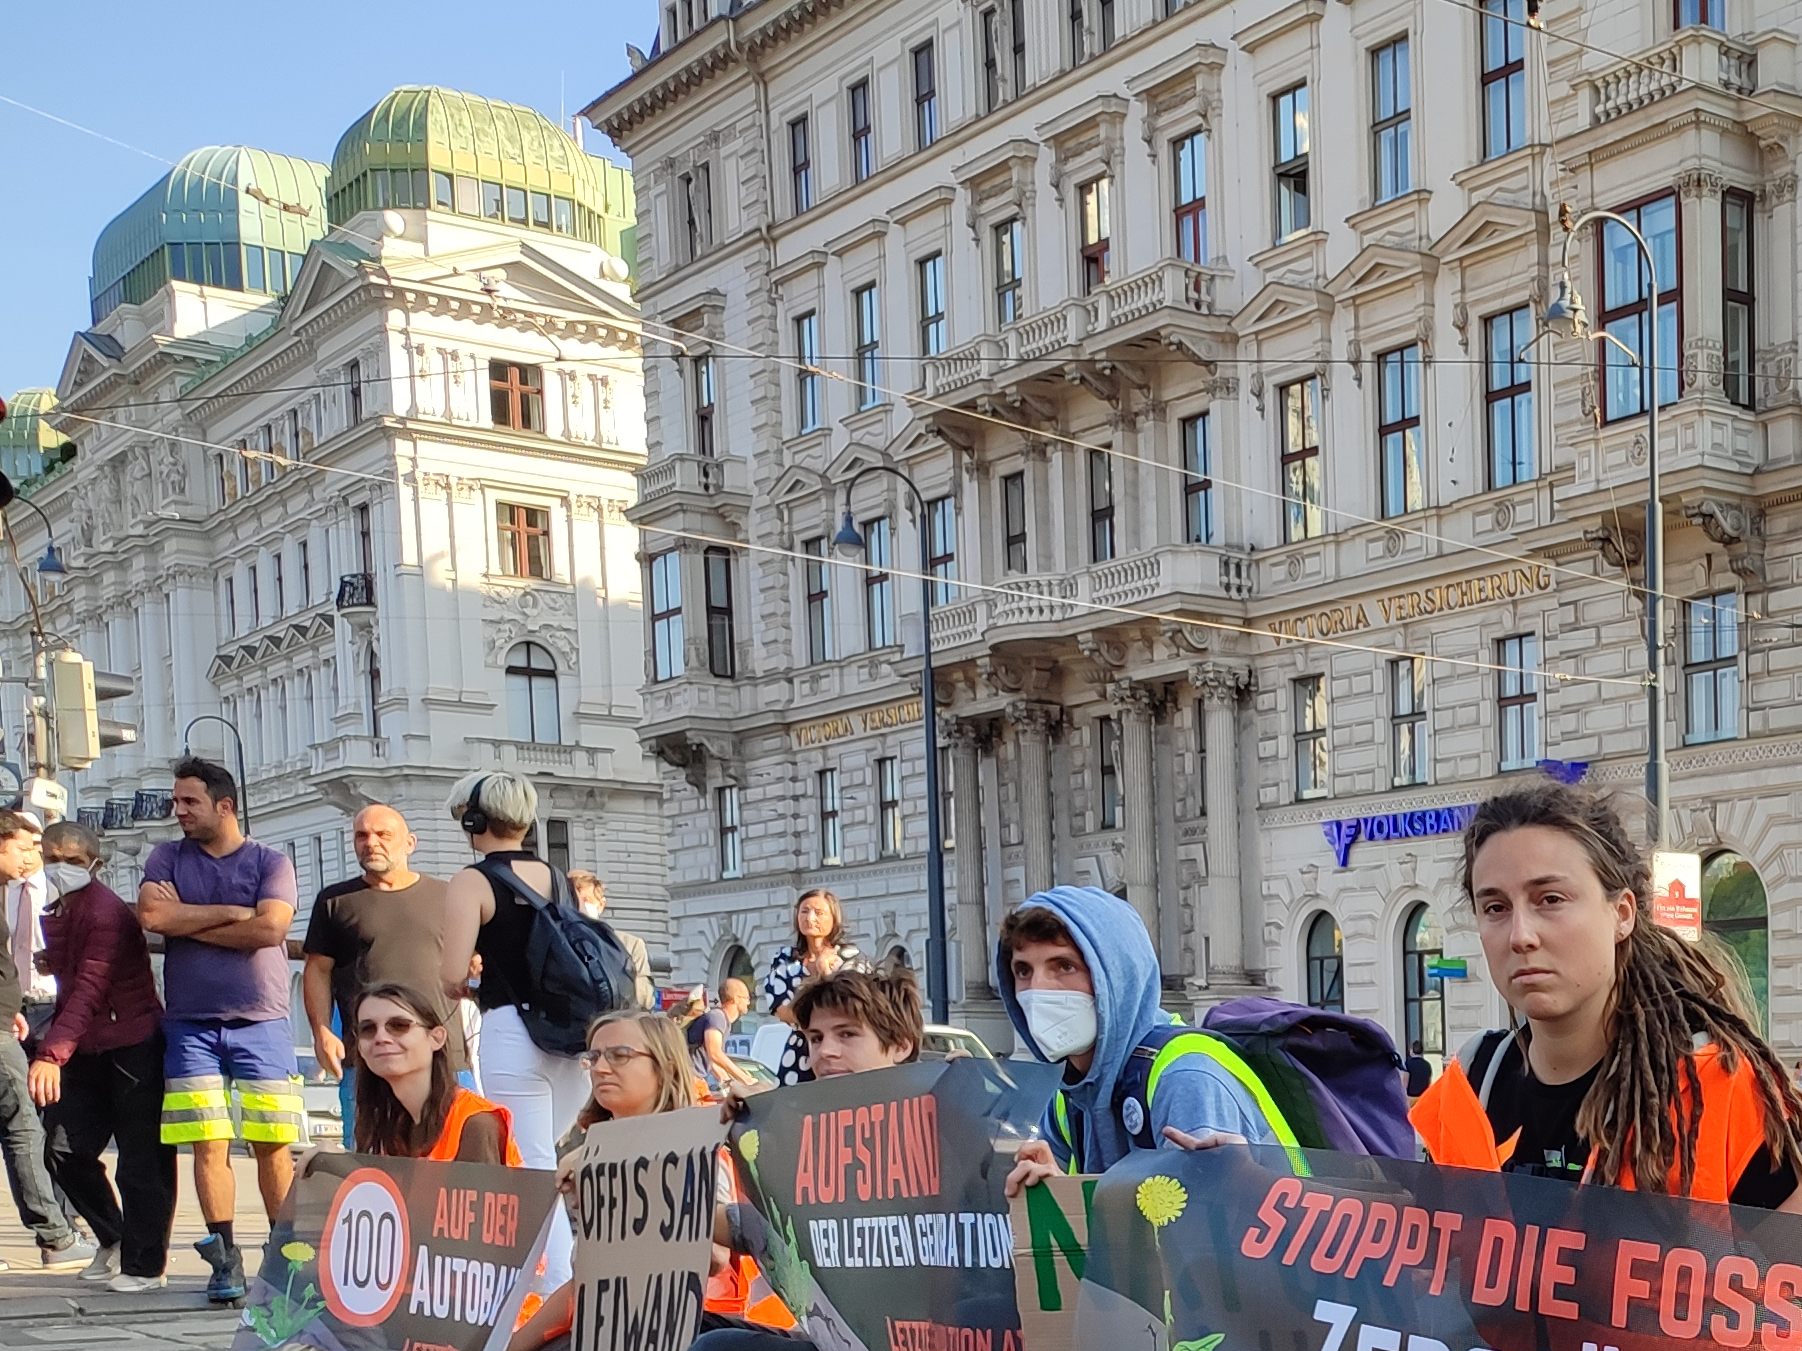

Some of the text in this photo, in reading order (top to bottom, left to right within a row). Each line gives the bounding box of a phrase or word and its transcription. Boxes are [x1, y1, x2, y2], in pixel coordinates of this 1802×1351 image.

[1268, 563, 1551, 647] VICTORIA VERSICHERUNG
[793, 716, 855, 747] VICTORIA
[1360, 804, 1477, 841] VOLKSBAN
[795, 1093, 940, 1206] AUFSTAND
[342, 1208, 396, 1290] 100
[432, 1187, 519, 1248] AUF DER
[808, 1217, 842, 1269] DER
[843, 1214, 916, 1269] LETZTEN
[1241, 1177, 1463, 1296] STOPPT
[1471, 1218, 1586, 1320] DIE
